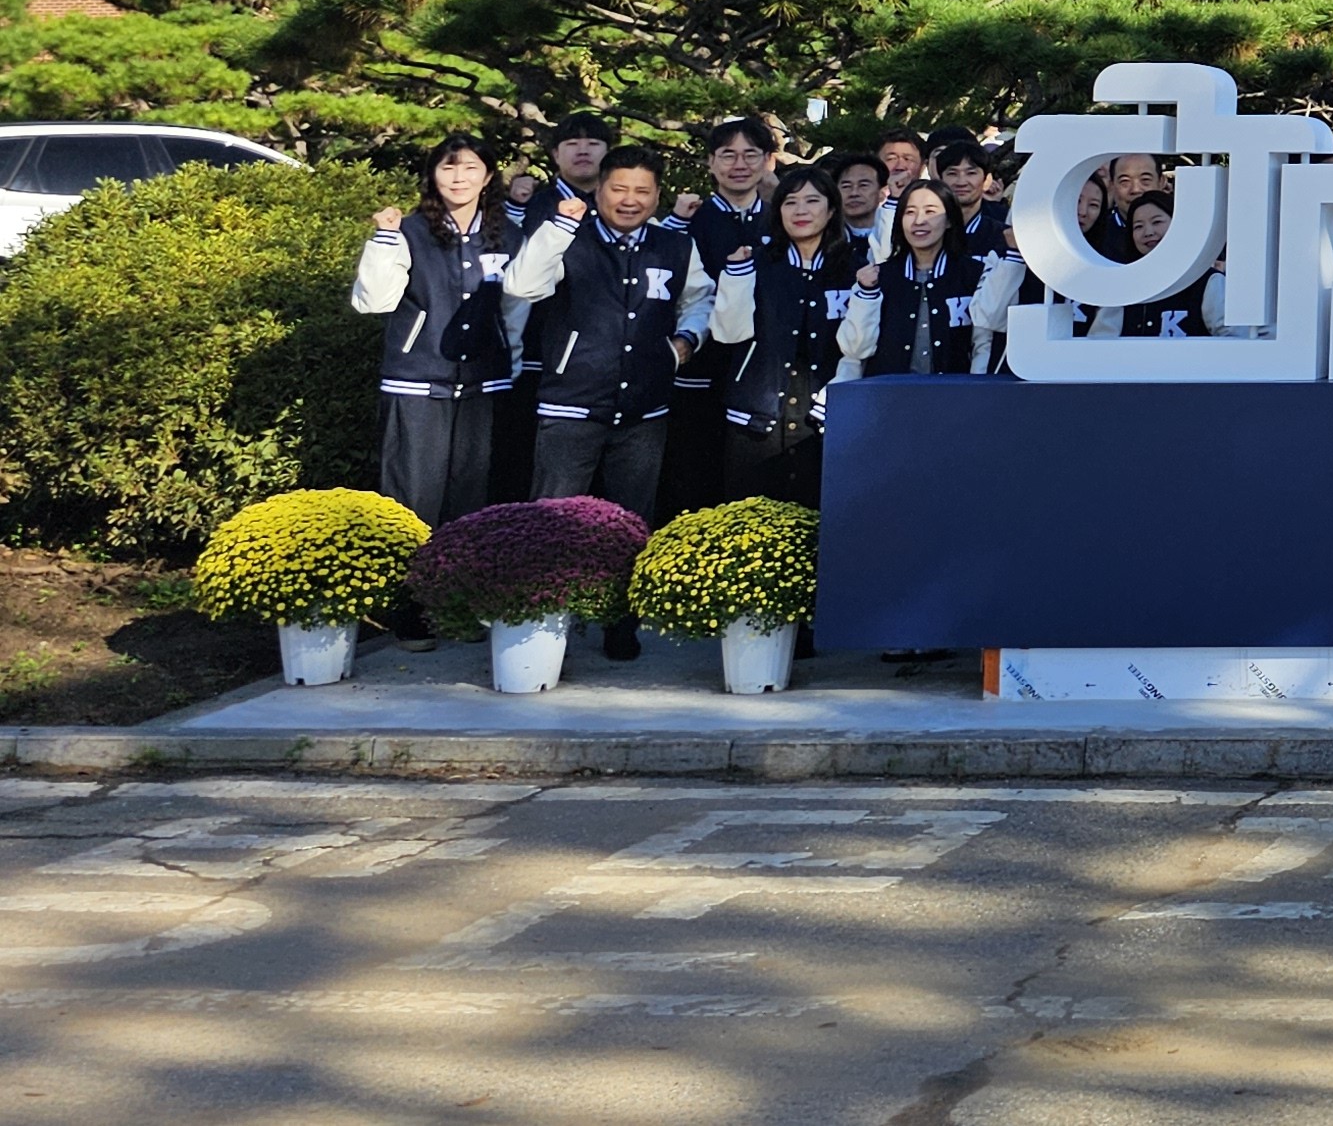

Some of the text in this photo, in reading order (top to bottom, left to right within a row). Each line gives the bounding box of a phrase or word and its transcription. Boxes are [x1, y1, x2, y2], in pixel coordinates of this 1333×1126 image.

[479, 253, 509, 282] K
[646, 267, 672, 301] K
[825, 289, 851, 320] K
[946, 296, 973, 328] K
[1160, 310, 1188, 337] K
